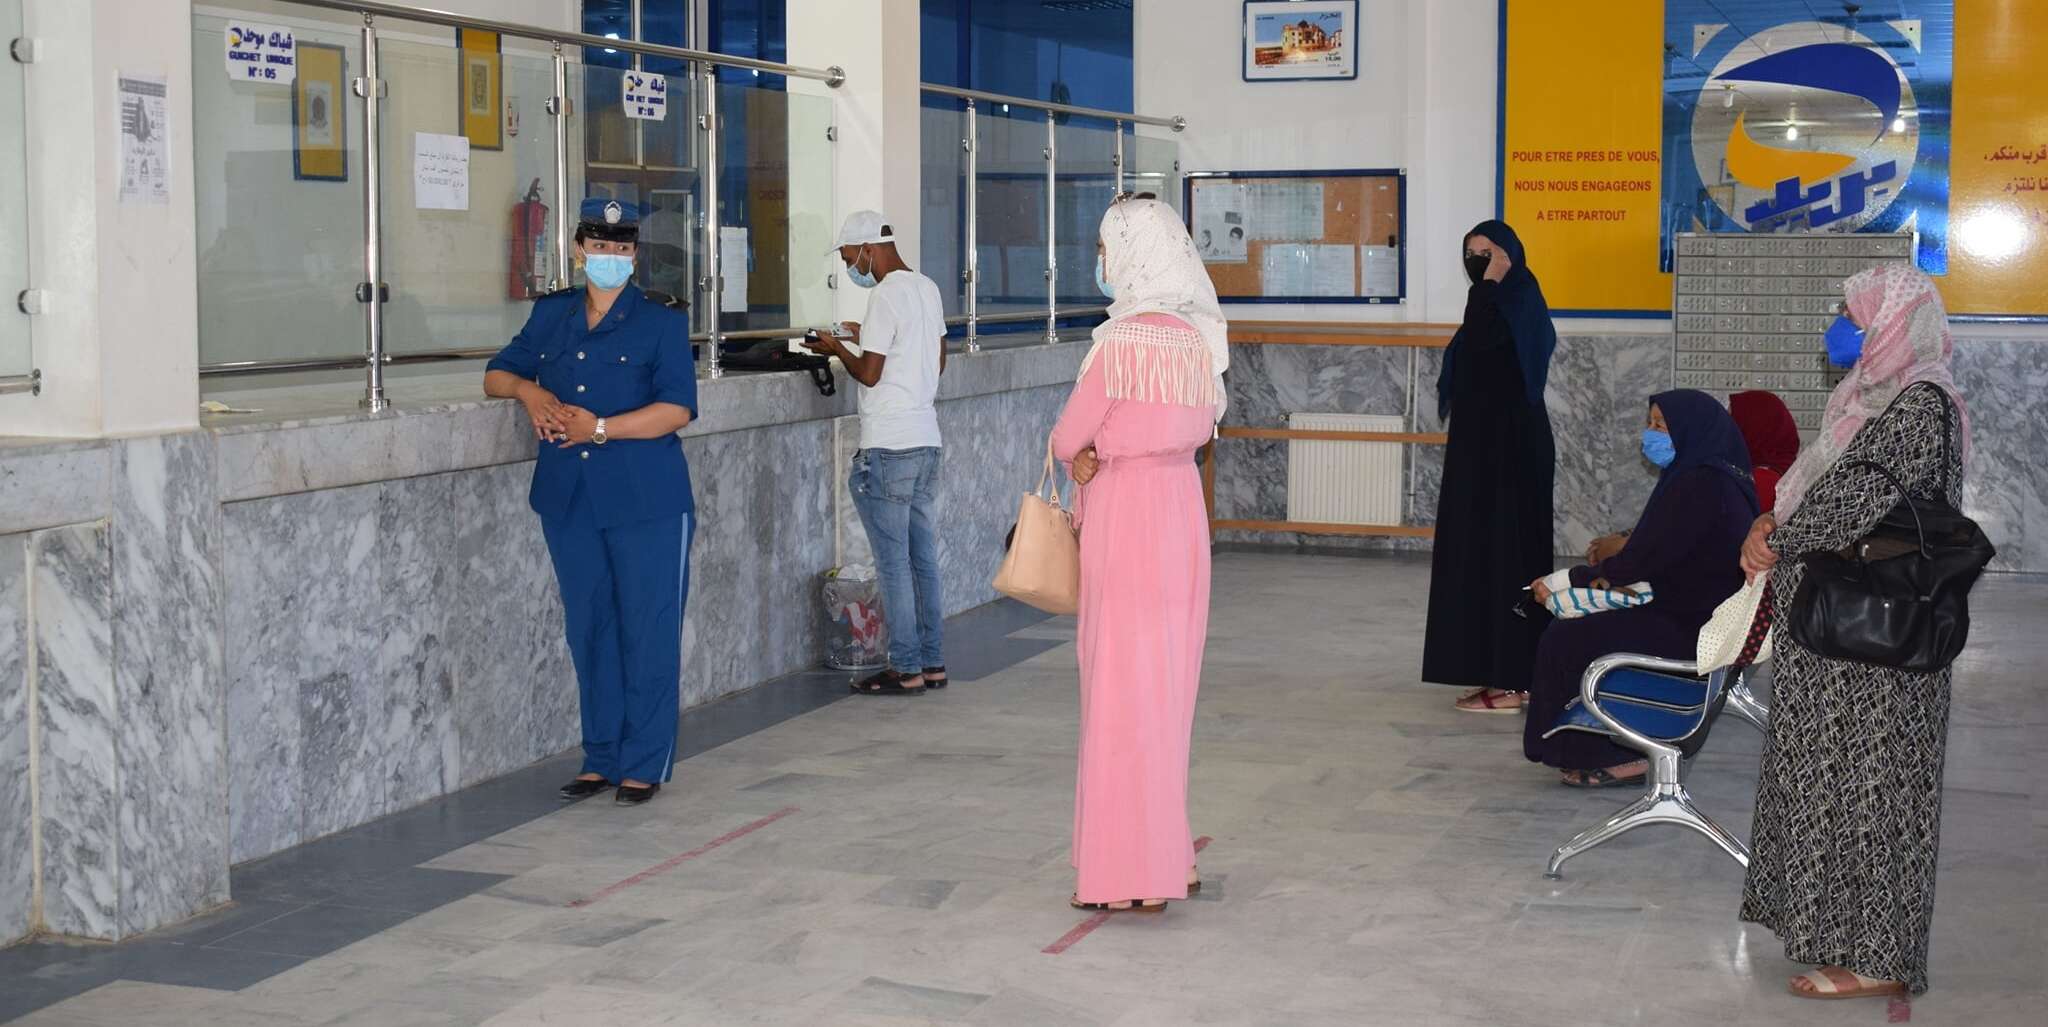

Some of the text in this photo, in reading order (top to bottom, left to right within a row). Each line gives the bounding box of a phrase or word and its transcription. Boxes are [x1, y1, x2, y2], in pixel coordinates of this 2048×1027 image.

[268, 32, 293, 52] شباك
[228, 50, 294, 66] GUICHET UNIQUE
[1512, 151, 1661, 164] POUR ETRE PRES DE VOUS,
[2021, 144, 2047, 165] قرب
[1514, 180, 1652, 192] NOUS NOUS ENGAGEONS
[1536, 210, 1627, 221] A ETRE PARTOUT
